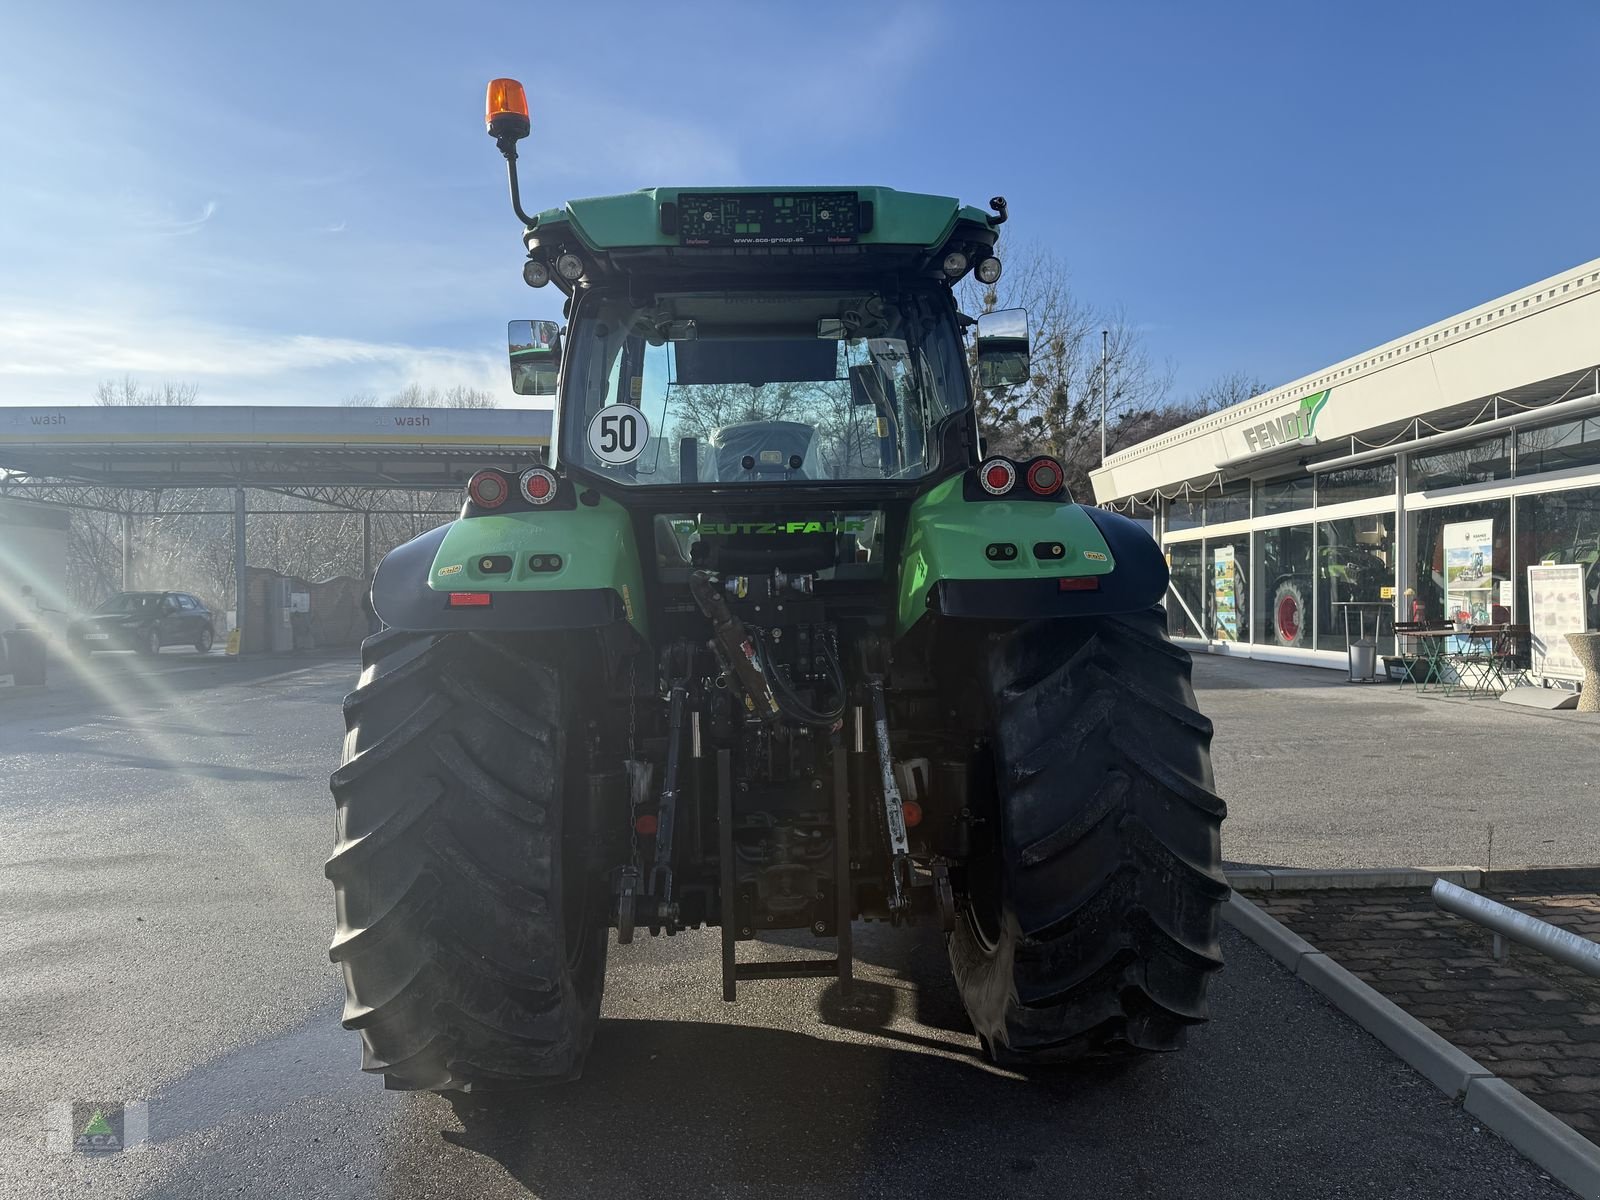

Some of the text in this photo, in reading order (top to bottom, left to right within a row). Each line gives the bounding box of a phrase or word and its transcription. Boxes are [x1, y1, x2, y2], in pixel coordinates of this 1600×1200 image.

[30, 413, 66, 425] wash
[394, 414, 430, 426] wash
[1242, 406, 1312, 453] FENDT
[601, 415, 636, 453] 50
